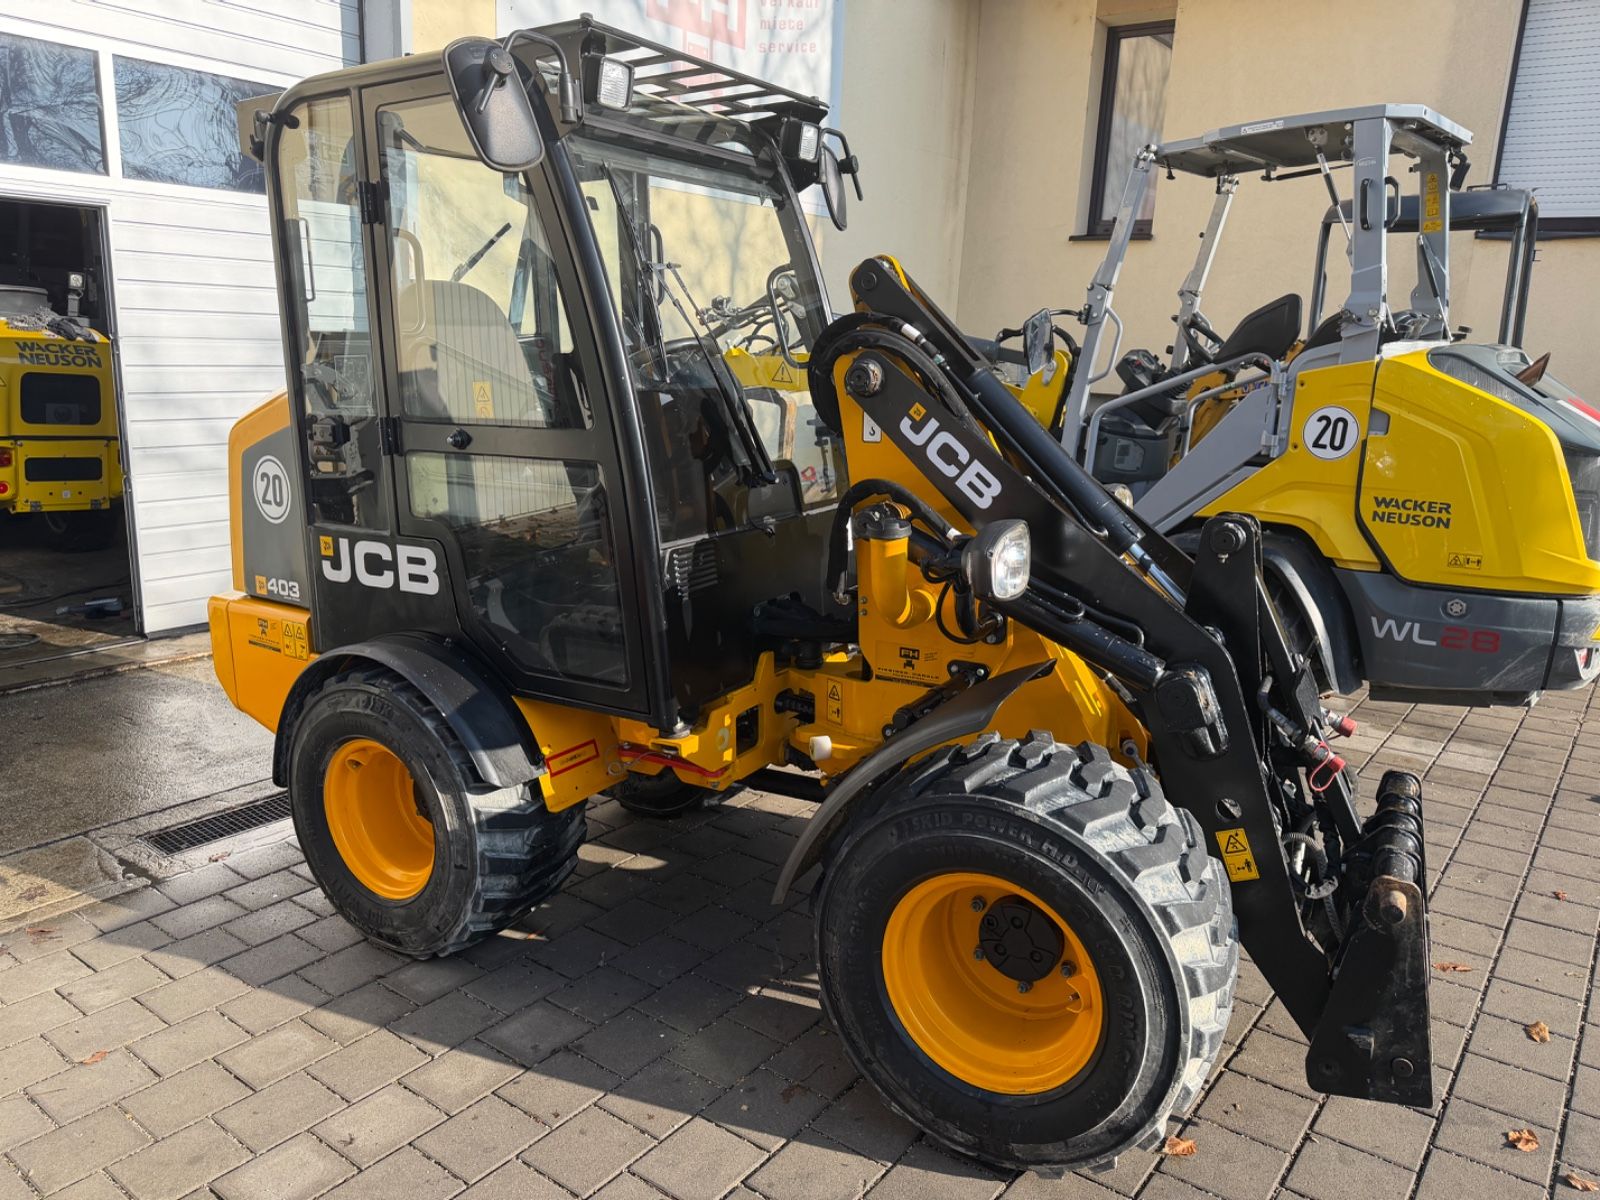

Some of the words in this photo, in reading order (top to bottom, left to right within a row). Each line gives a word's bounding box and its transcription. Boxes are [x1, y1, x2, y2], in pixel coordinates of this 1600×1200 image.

[760, 16, 803, 30] miete
[758, 42, 816, 53] service
[15, 341, 98, 356] WACKER
[18, 352, 102, 368] NEUSON
[1312, 415, 1348, 451] 20
[900, 416, 1002, 509] JCB
[260, 472, 283, 507] 20
[1373, 496, 1452, 515] WACKER
[1372, 510, 1451, 529] NEUSON
[321, 537, 440, 596] JCB
[268, 578, 300, 598] 403
